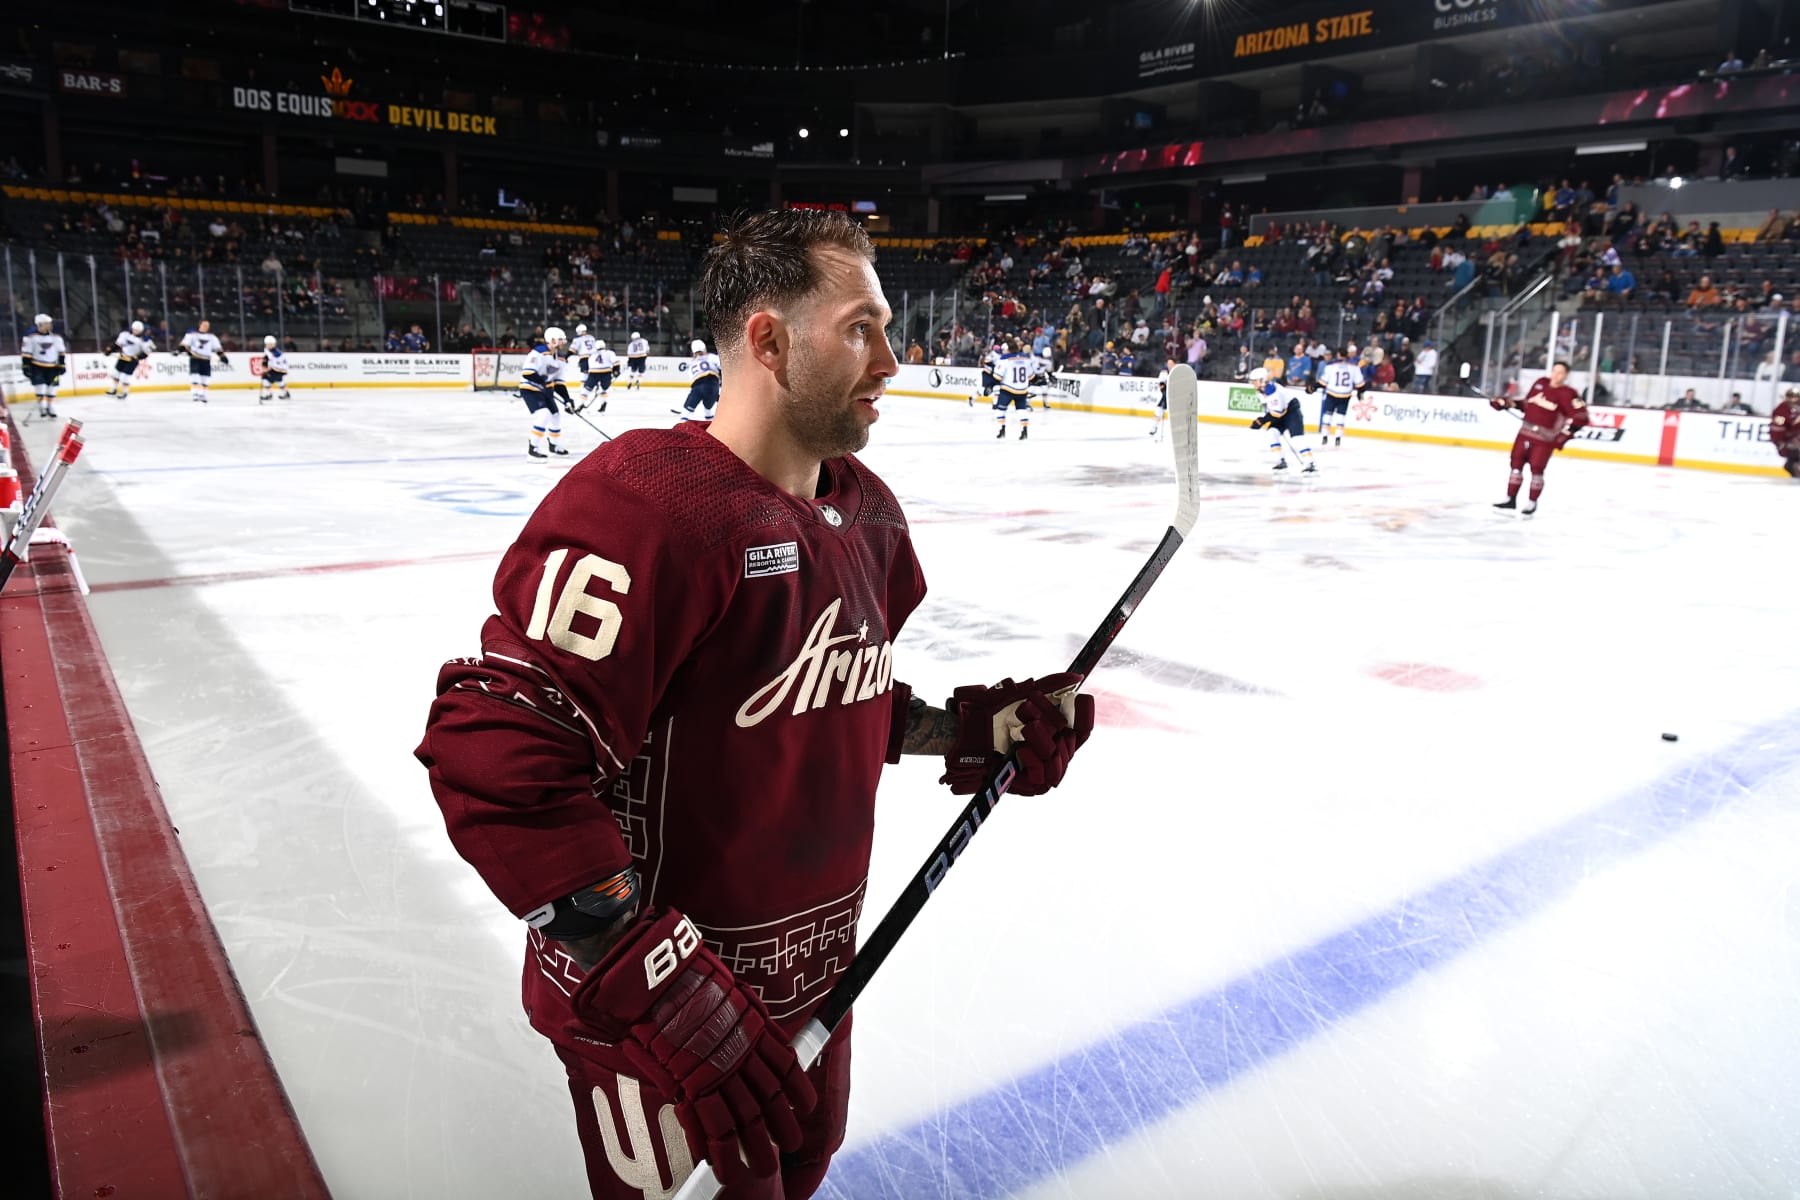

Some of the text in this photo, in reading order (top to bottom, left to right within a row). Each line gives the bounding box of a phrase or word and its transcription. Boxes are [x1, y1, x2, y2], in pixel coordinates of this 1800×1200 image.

[1433, 8, 1497, 30] BUSINESS
[1234, 10, 1375, 58] ARIZONA STATE
[1139, 49, 1163, 63] GILA
[1164, 42, 1196, 57] RIVER
[63, 72, 121, 93] BAR-S
[233, 86, 272, 111] DOS
[276, 92, 333, 118] EQUIS
[388, 104, 444, 130] DEVIL
[447, 111, 497, 136] DECK
[724, 147, 774, 158] Mortenson
[157, 361, 188, 376] Dignit
[1012, 366, 1027, 383] 18
[945, 374, 977, 387] Stantec
[1119, 381, 1144, 392] NOBLE
[1334, 371, 1350, 387] 12
[1383, 404, 1428, 422] Dignity
[749, 549, 773, 561] GILA
[774, 545, 796, 558] RIVER
[525, 548, 632, 662] 16
[735, 597, 893, 728] Arizo
